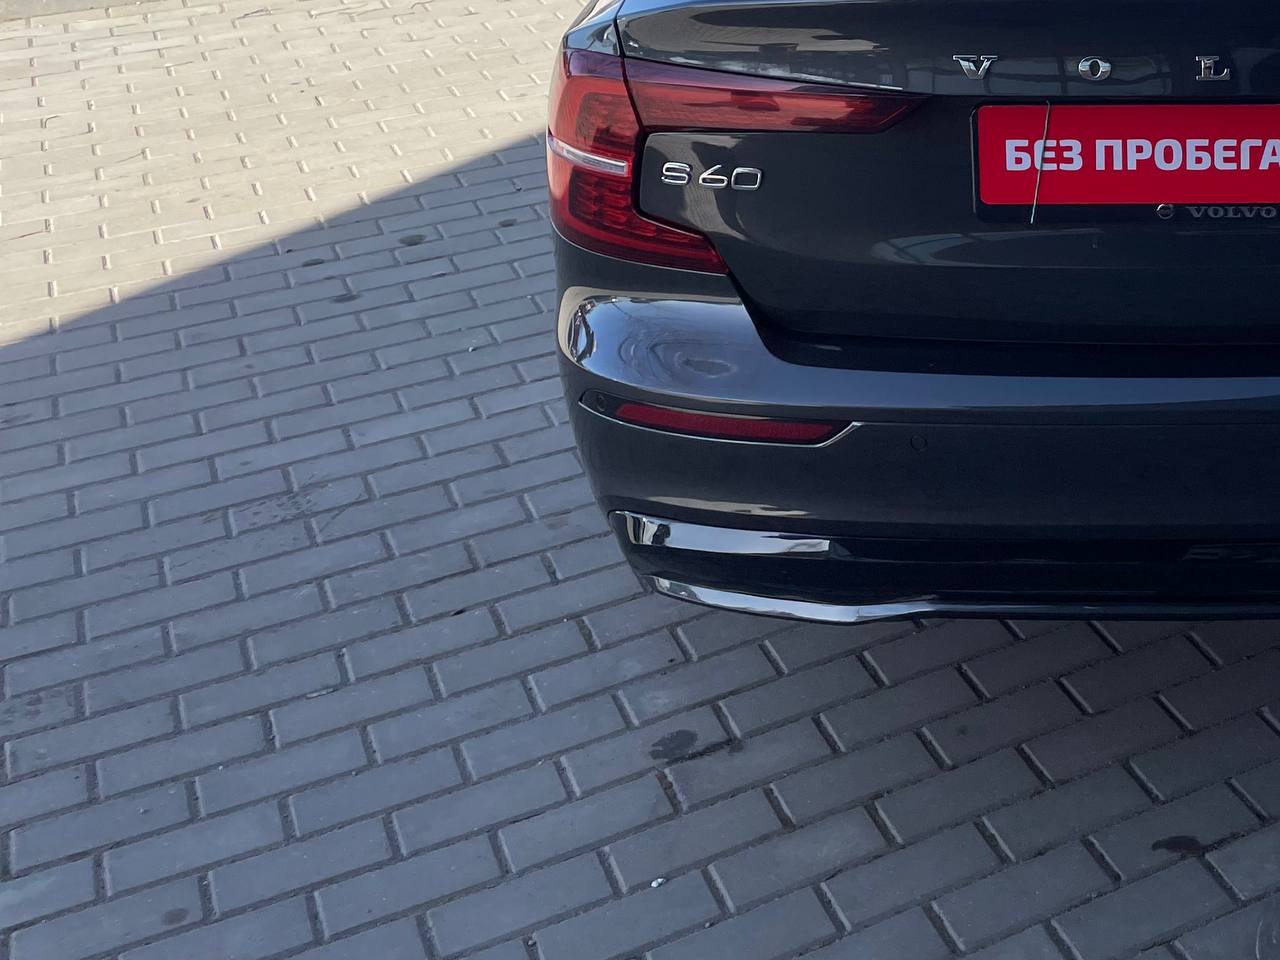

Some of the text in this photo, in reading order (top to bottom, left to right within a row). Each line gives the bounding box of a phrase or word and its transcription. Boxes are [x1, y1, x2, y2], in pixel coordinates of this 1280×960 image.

[1004, 139, 1083, 171] БЕЗ
[661, 161, 762, 191] S60
[1186, 205, 1278, 219] VOLVO
